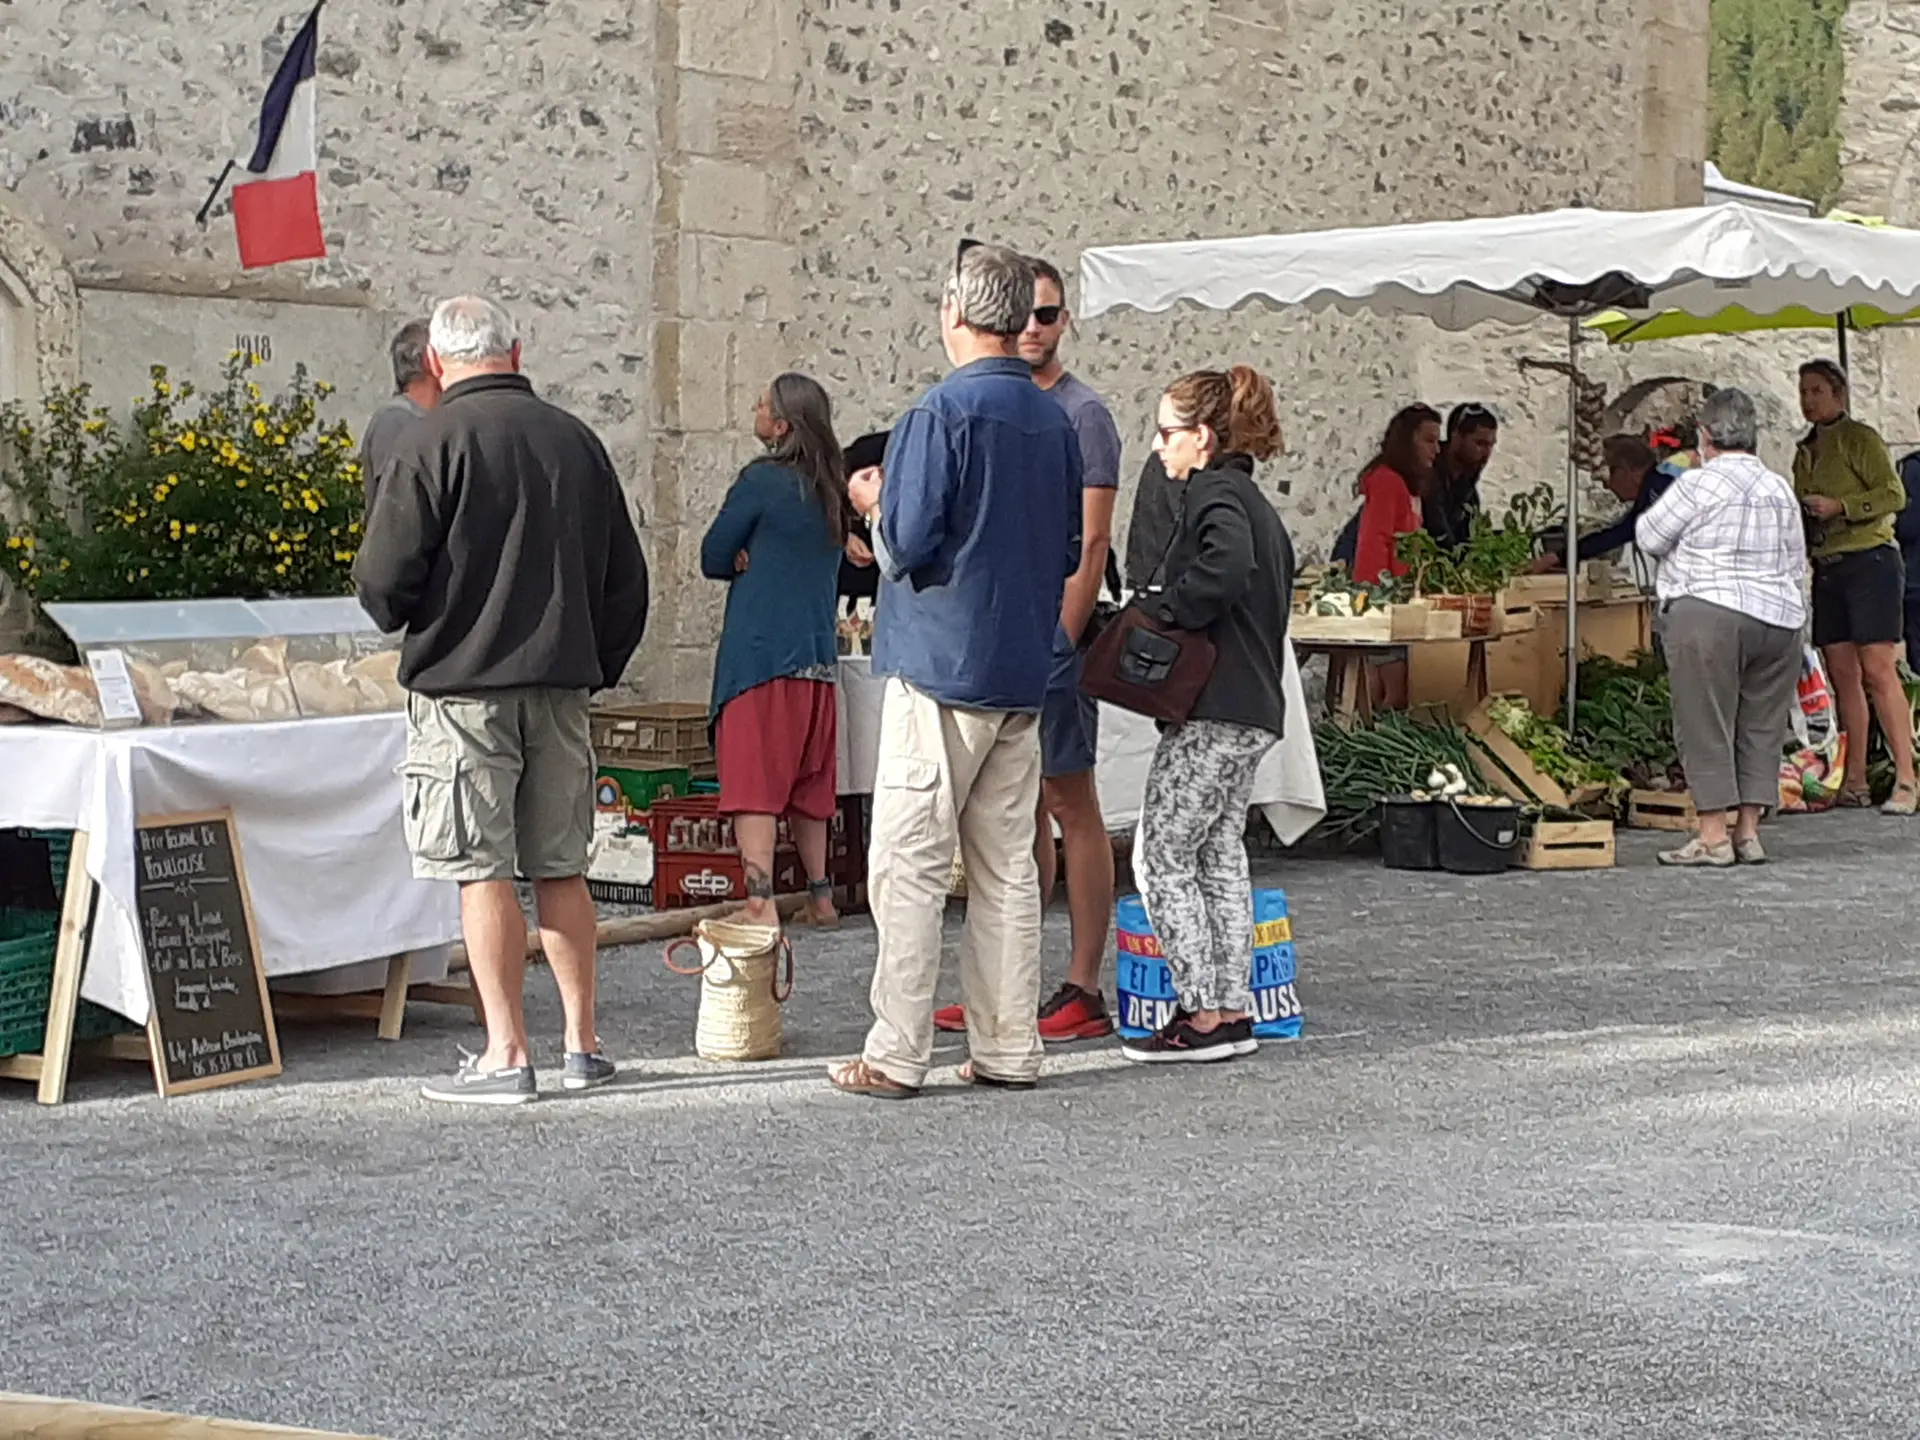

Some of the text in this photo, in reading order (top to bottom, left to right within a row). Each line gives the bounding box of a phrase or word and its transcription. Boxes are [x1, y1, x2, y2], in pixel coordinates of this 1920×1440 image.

[235, 334, 272, 362] 1918
[1130, 961, 1148, 992] ET
[1159, 966, 1173, 994] P
